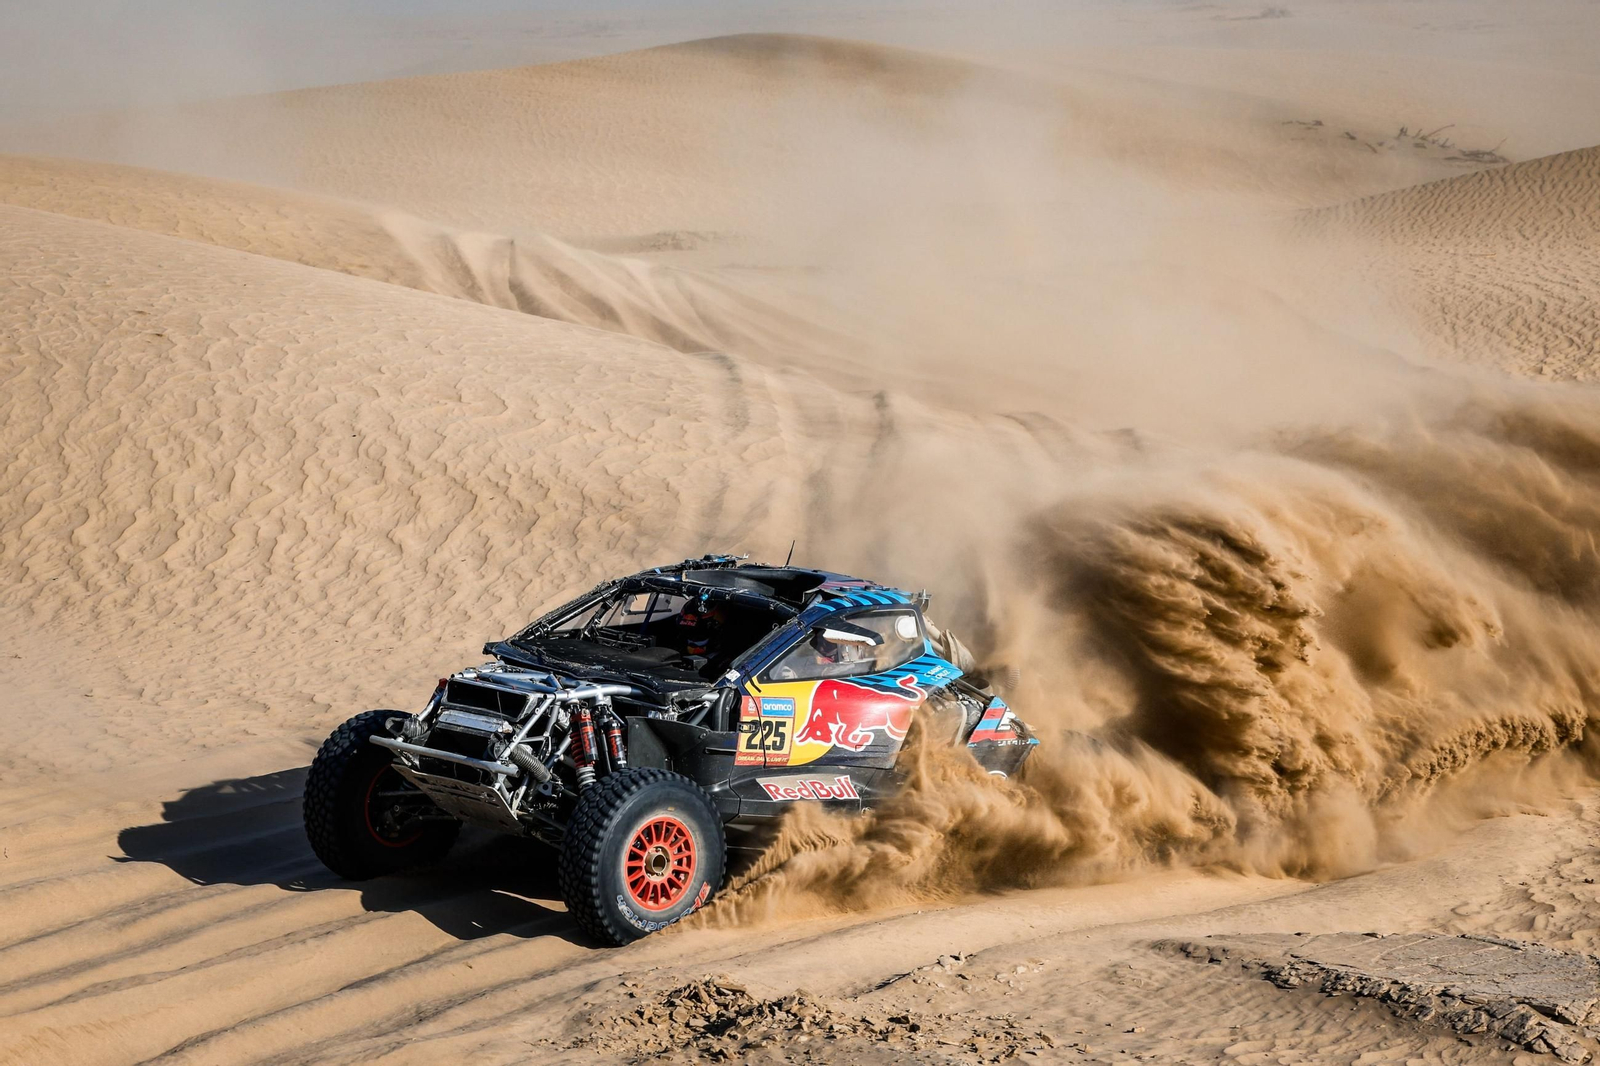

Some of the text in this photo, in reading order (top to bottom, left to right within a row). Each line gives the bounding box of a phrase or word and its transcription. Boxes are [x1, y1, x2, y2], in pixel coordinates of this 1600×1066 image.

[763, 703, 792, 711] aramco
[746, 720, 786, 751] 225
[761, 775, 859, 800] Red Bull
